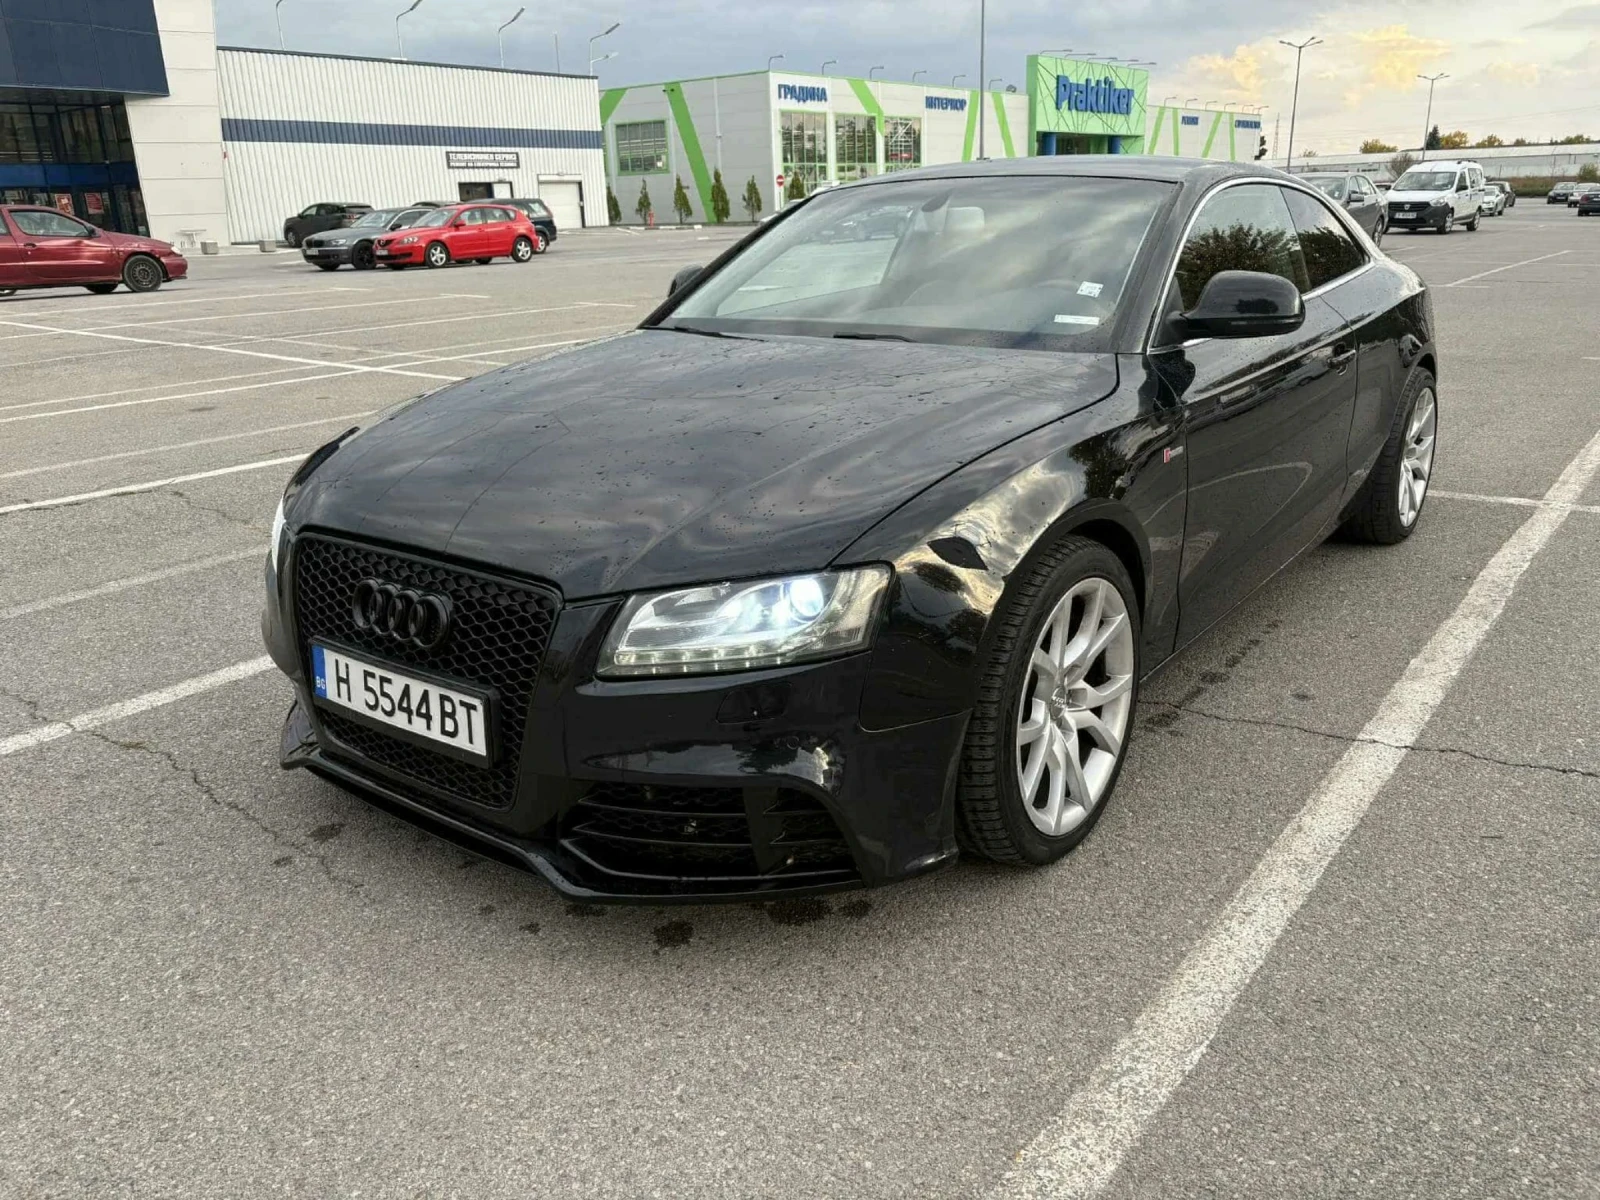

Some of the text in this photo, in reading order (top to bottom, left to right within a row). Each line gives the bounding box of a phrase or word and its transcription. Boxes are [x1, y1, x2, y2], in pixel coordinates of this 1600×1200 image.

[777, 83, 828, 104] ГРАДИНА
[1055, 75, 1135, 115] Praktiker
[315, 675, 326, 690] BG
[335, 658, 352, 703] H
